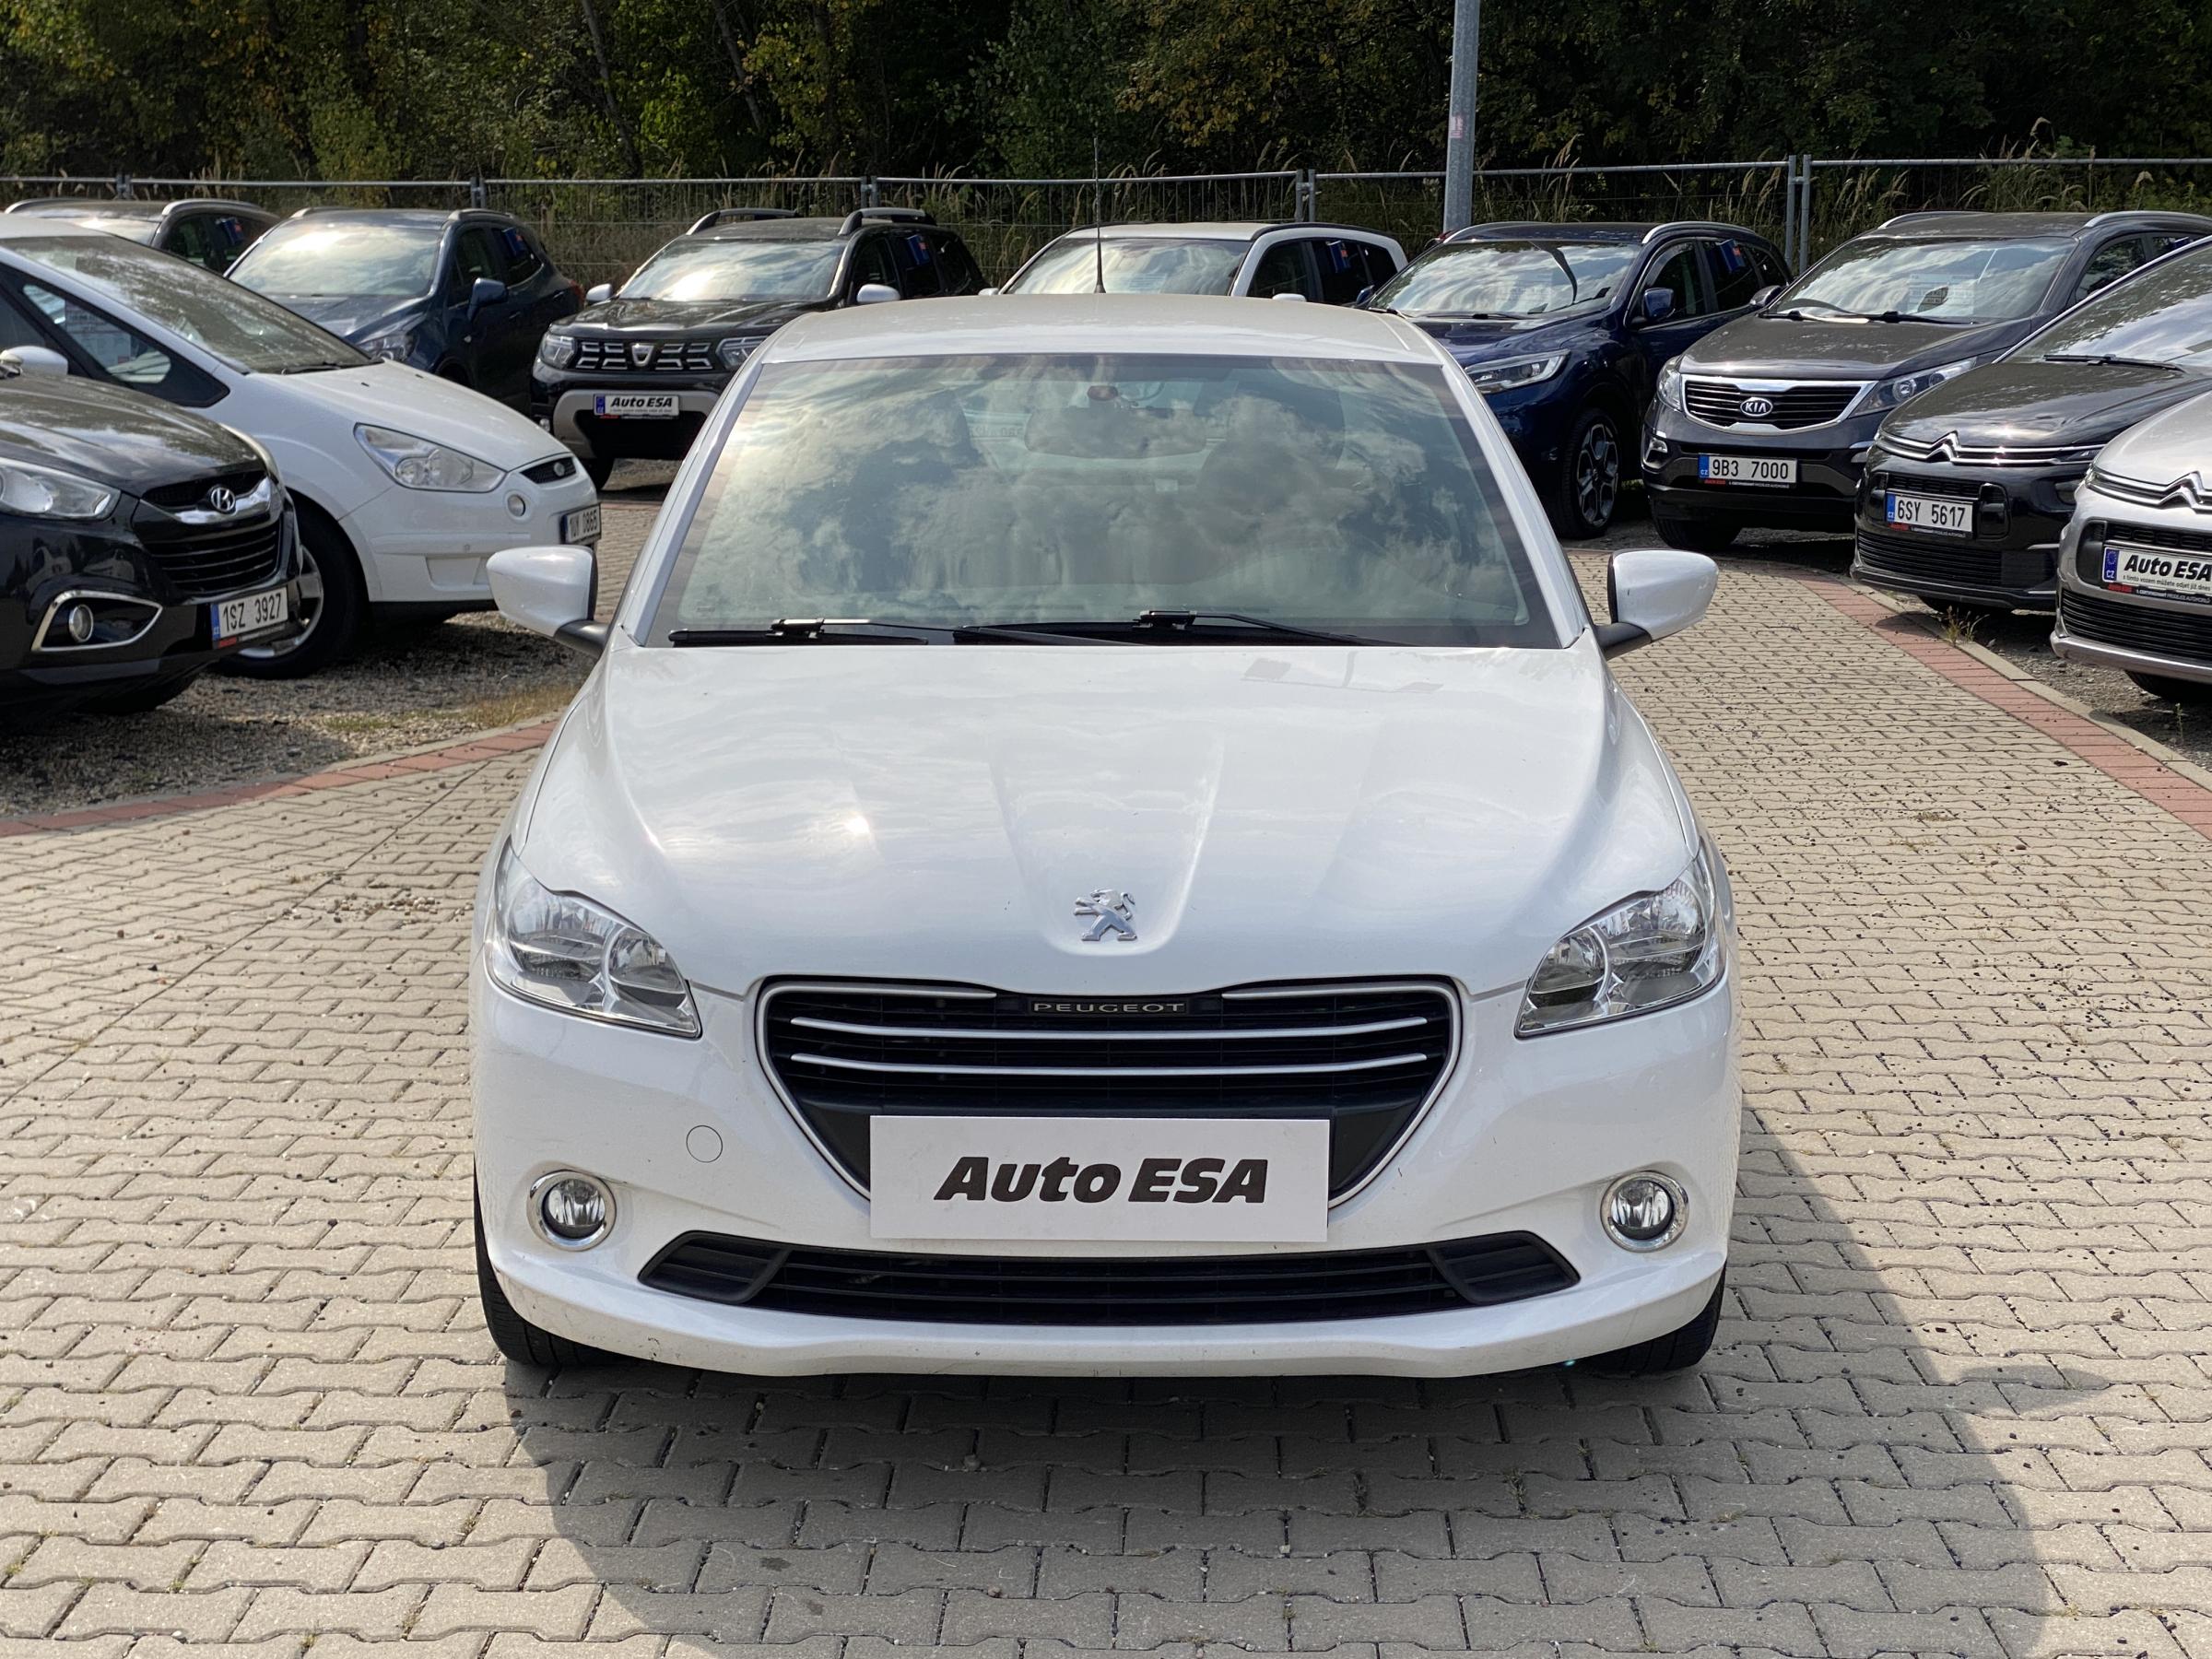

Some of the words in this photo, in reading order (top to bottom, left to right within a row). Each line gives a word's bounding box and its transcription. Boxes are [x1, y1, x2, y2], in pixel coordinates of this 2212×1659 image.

[611, 397, 645, 407] Auto
[646, 397, 673, 407] ESA
[1745, 402, 1767, 413] KIA
[1712, 459, 1739, 477] 9B3
[1751, 461, 1789, 479] 7000
[1898, 500, 1922, 522] 6SY
[1931, 503, 1966, 528] 5617
[2105, 570, 2114, 579] CZ
[2124, 554, 2172, 577] Auto
[2173, 560, 2212, 582] ESA
[223, 601, 246, 633] 1SZ
[254, 592, 281, 624] 3927
[1032, 1003, 1184, 1012] PEUGEOT
[933, 1156, 1122, 1204] Auto
[1127, 1158, 1268, 1204] ESA
